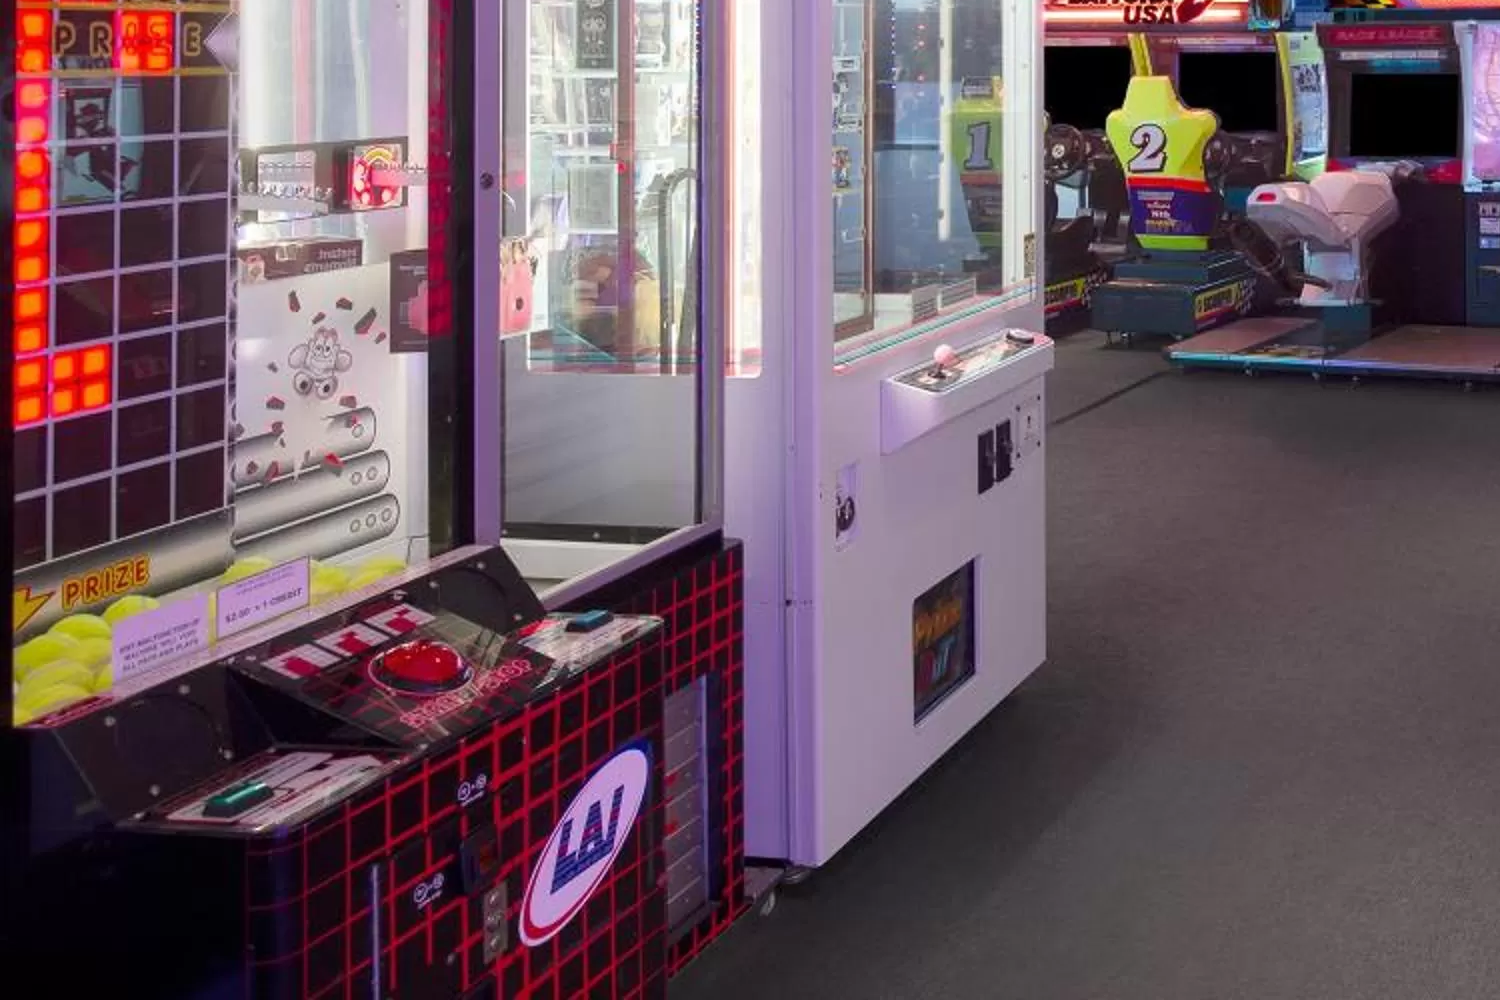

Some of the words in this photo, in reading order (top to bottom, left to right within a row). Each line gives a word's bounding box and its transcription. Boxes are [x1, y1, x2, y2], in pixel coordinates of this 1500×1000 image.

[51, 20, 202, 58] PRIZE
[1123, 5, 1175, 25] USA
[963, 120, 993, 170] 1
[1128, 123, 1167, 173] 2
[61, 555, 150, 610] PRIZE
[550, 784, 624, 895] LAI
